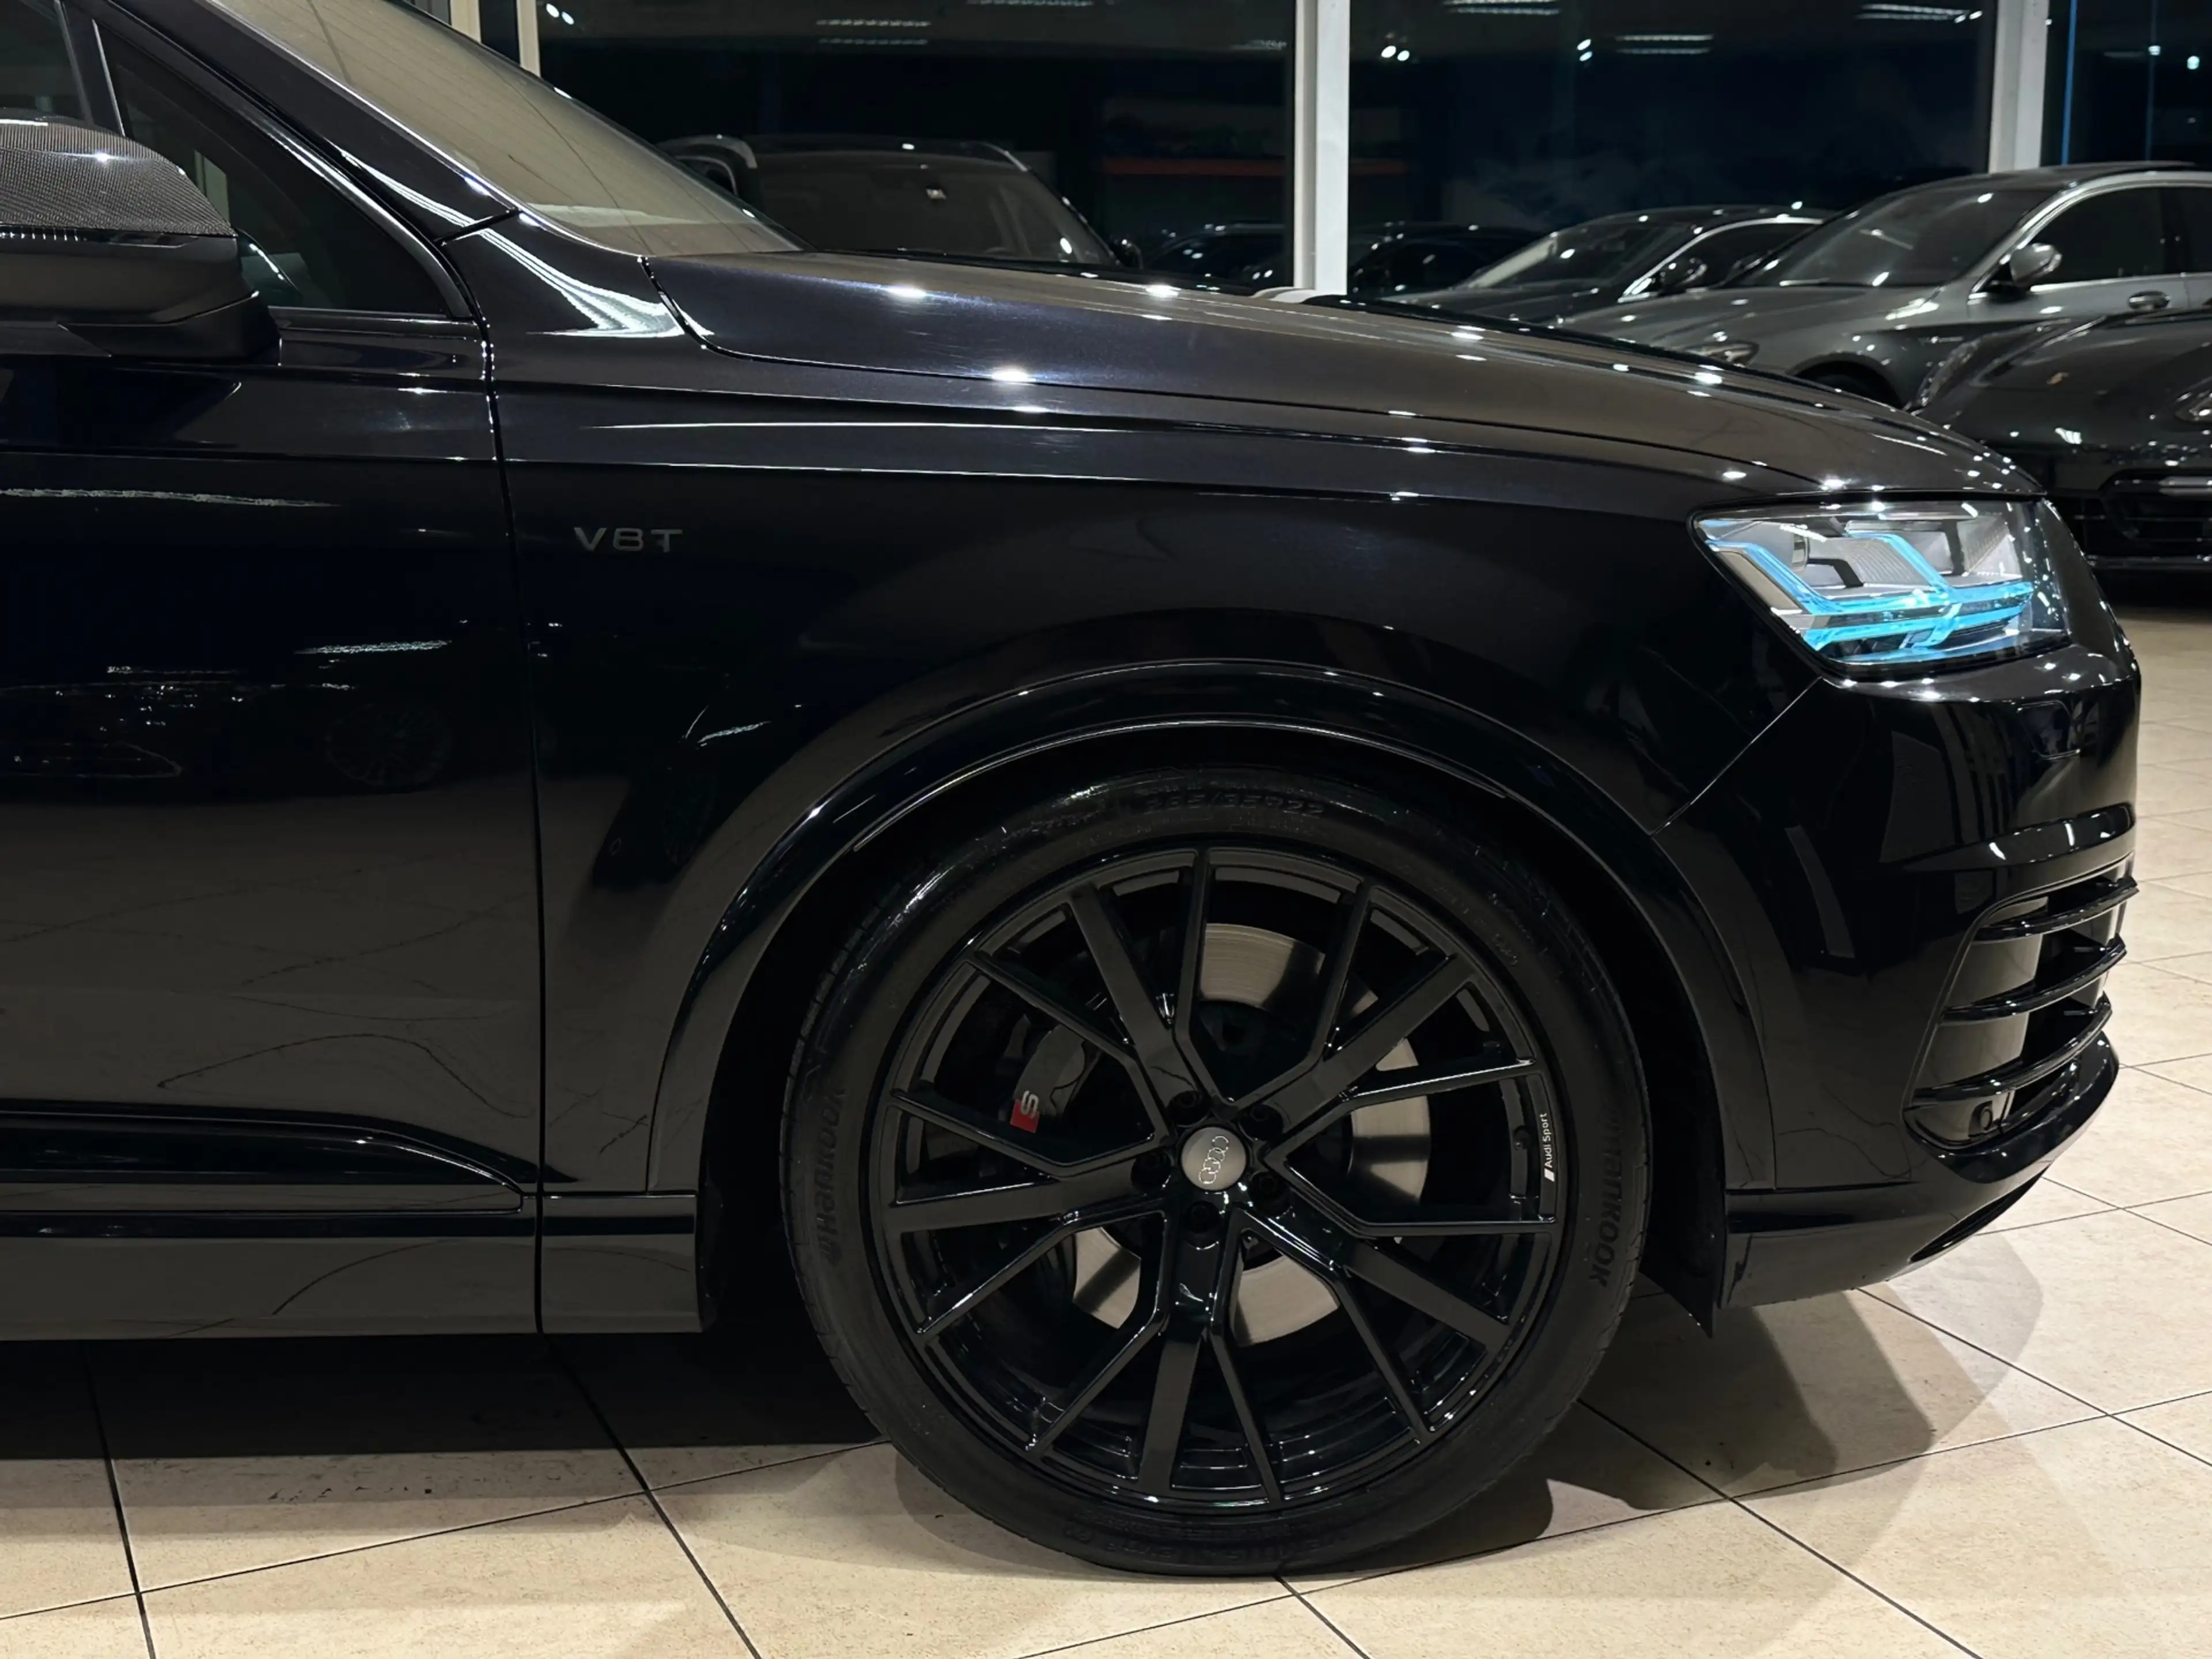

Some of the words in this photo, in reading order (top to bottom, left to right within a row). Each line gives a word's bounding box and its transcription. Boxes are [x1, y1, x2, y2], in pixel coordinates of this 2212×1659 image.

[573, 527, 684, 553] V8T
[1020, 1090, 1039, 1120] S
[1539, 1112, 1552, 1142] Sport
[1543, 1143, 1553, 1169] Audi
